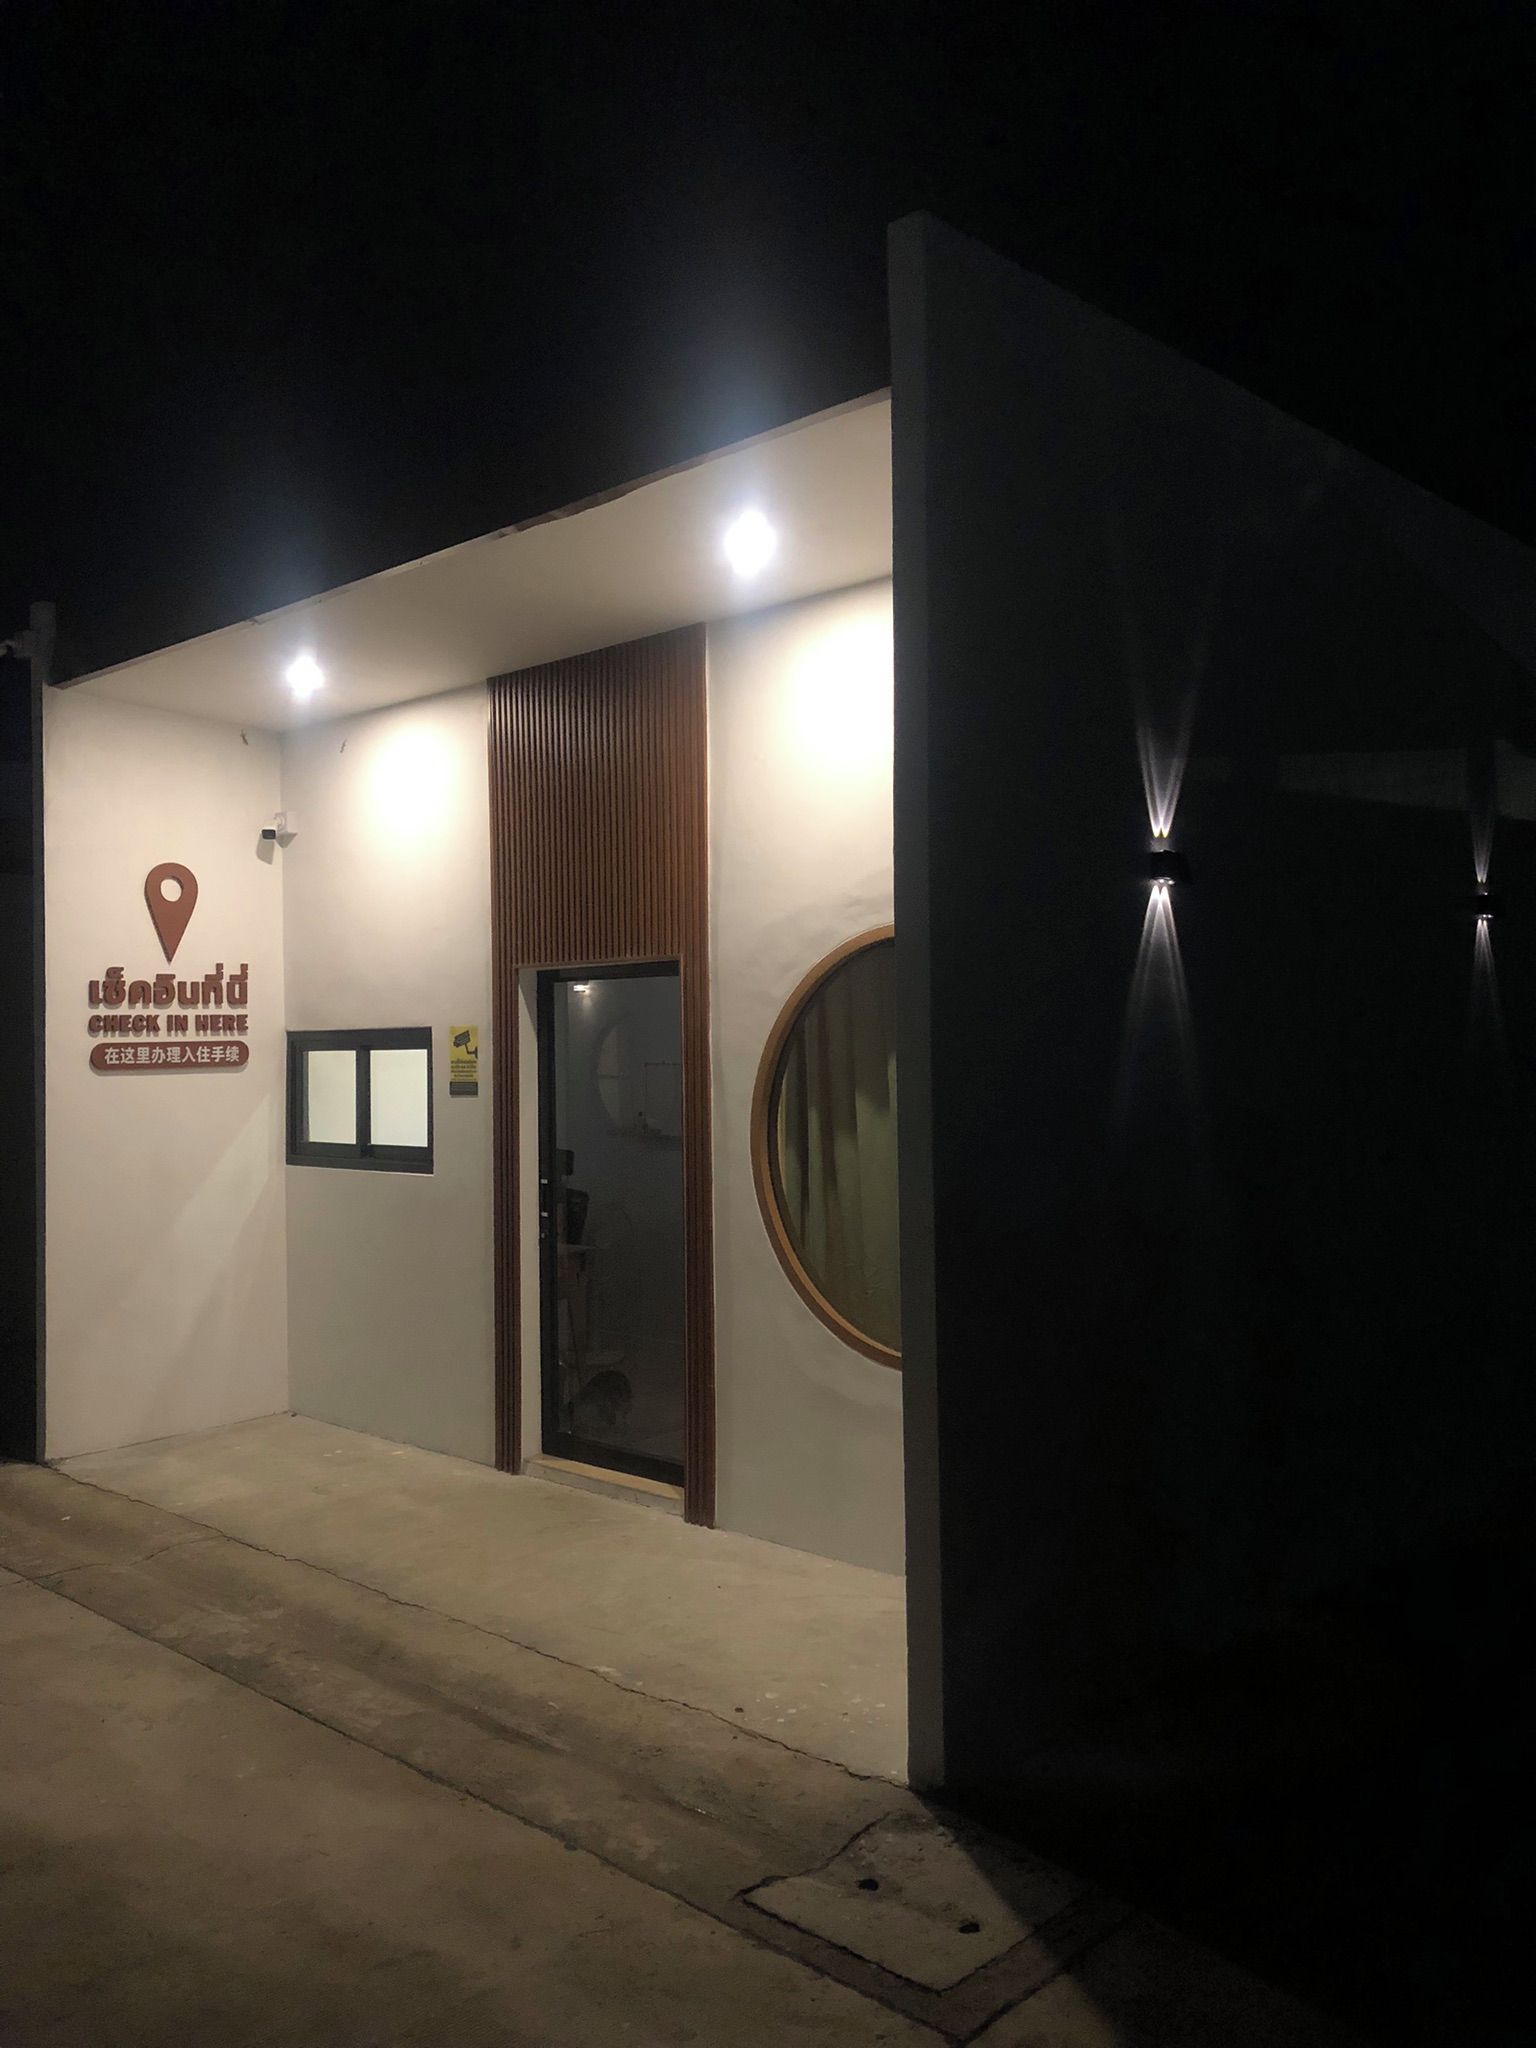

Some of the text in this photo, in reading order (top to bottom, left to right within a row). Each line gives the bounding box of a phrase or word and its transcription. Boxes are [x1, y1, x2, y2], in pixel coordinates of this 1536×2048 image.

[89, 963, 248, 1005] เช็คอินที่นี่
[89, 1014, 248, 1033] CHECK IN HERE
[104, 1046, 239, 1064] 在这里办理入住手续
